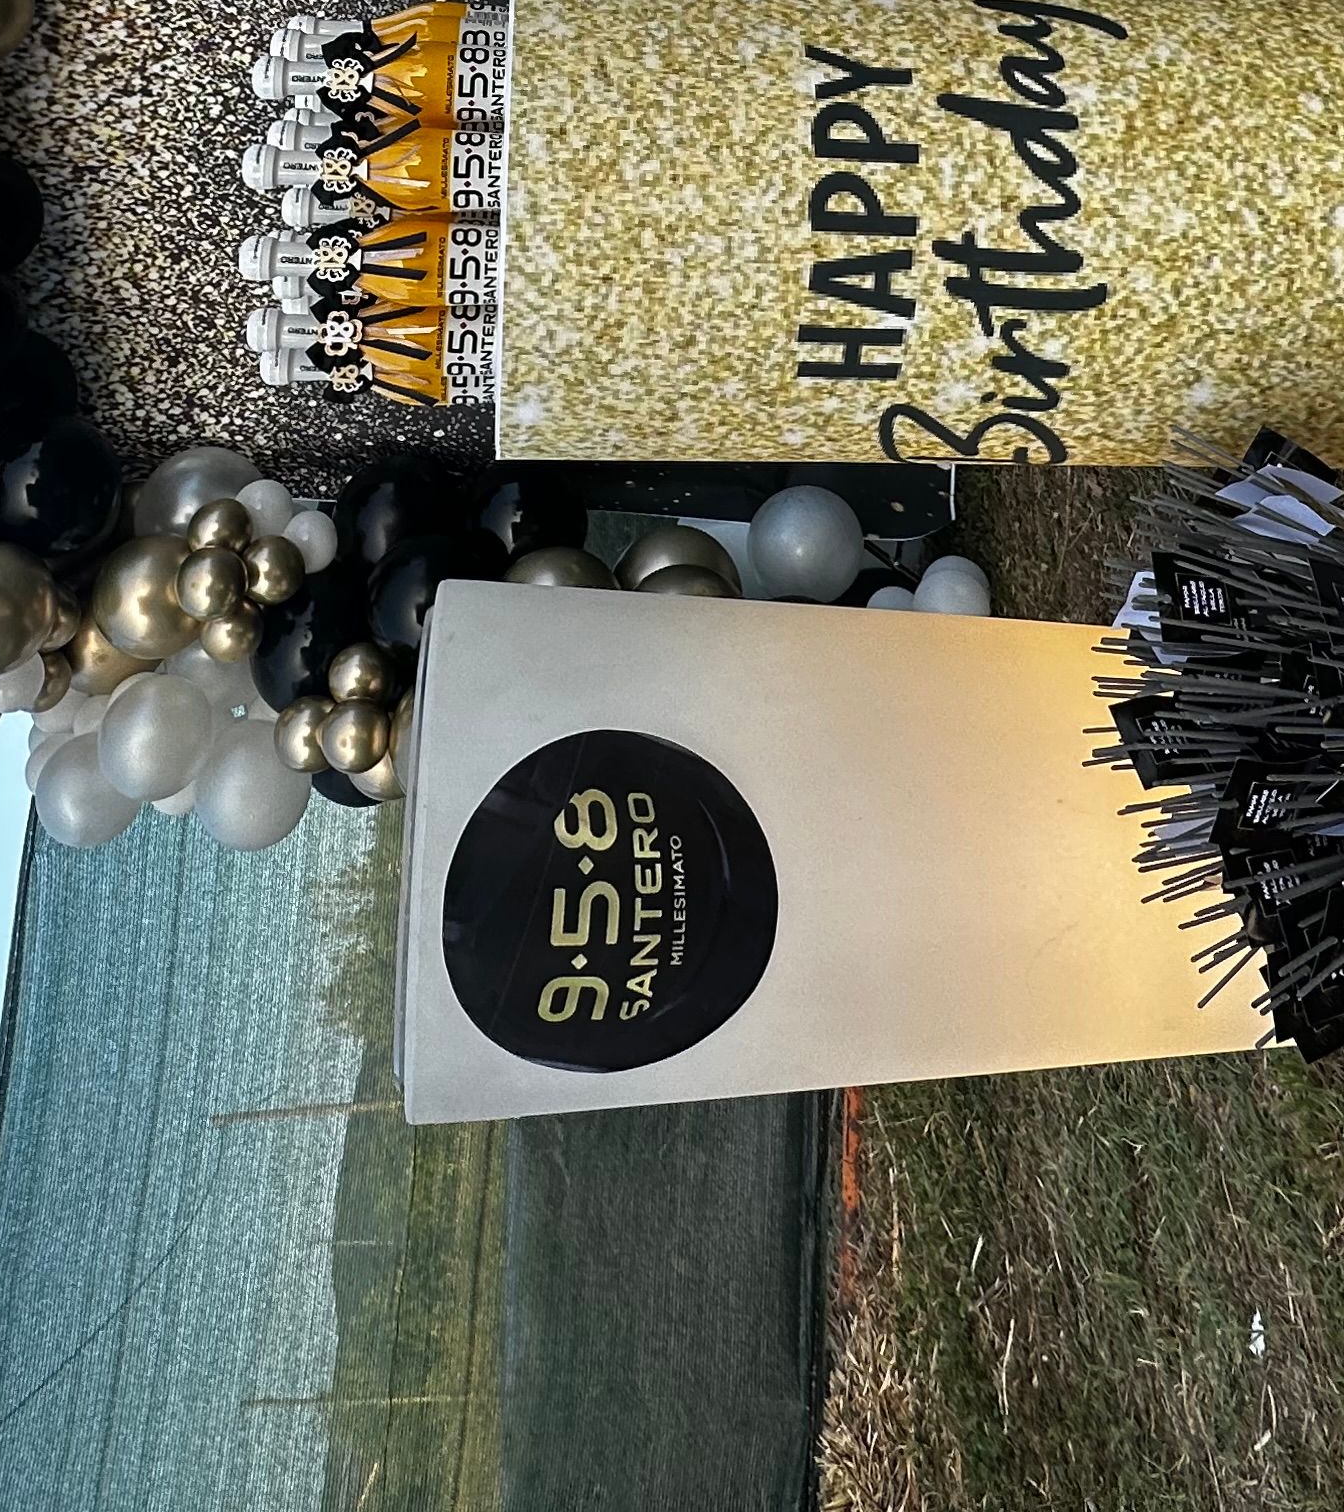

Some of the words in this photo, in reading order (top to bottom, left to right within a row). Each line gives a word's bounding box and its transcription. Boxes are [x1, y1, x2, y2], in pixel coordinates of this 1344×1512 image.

[282, 162, 319, 170] NTERO
[322, 158, 352, 182] 18
[440, 137, 450, 199] MILLESIMATO
[487, 134, 502, 208] SANTERO
[796, 43, 920, 381] HAPPY
[318, 246, 348, 270] 18
[436, 236, 446, 298] MILLESIMATO
[483, 229, 498, 304] SANTERO
[326, 320, 354, 346] 18
[619, 792, 663, 1020] SANTERO
[669, 835, 686, 966] MILLESIMATO
